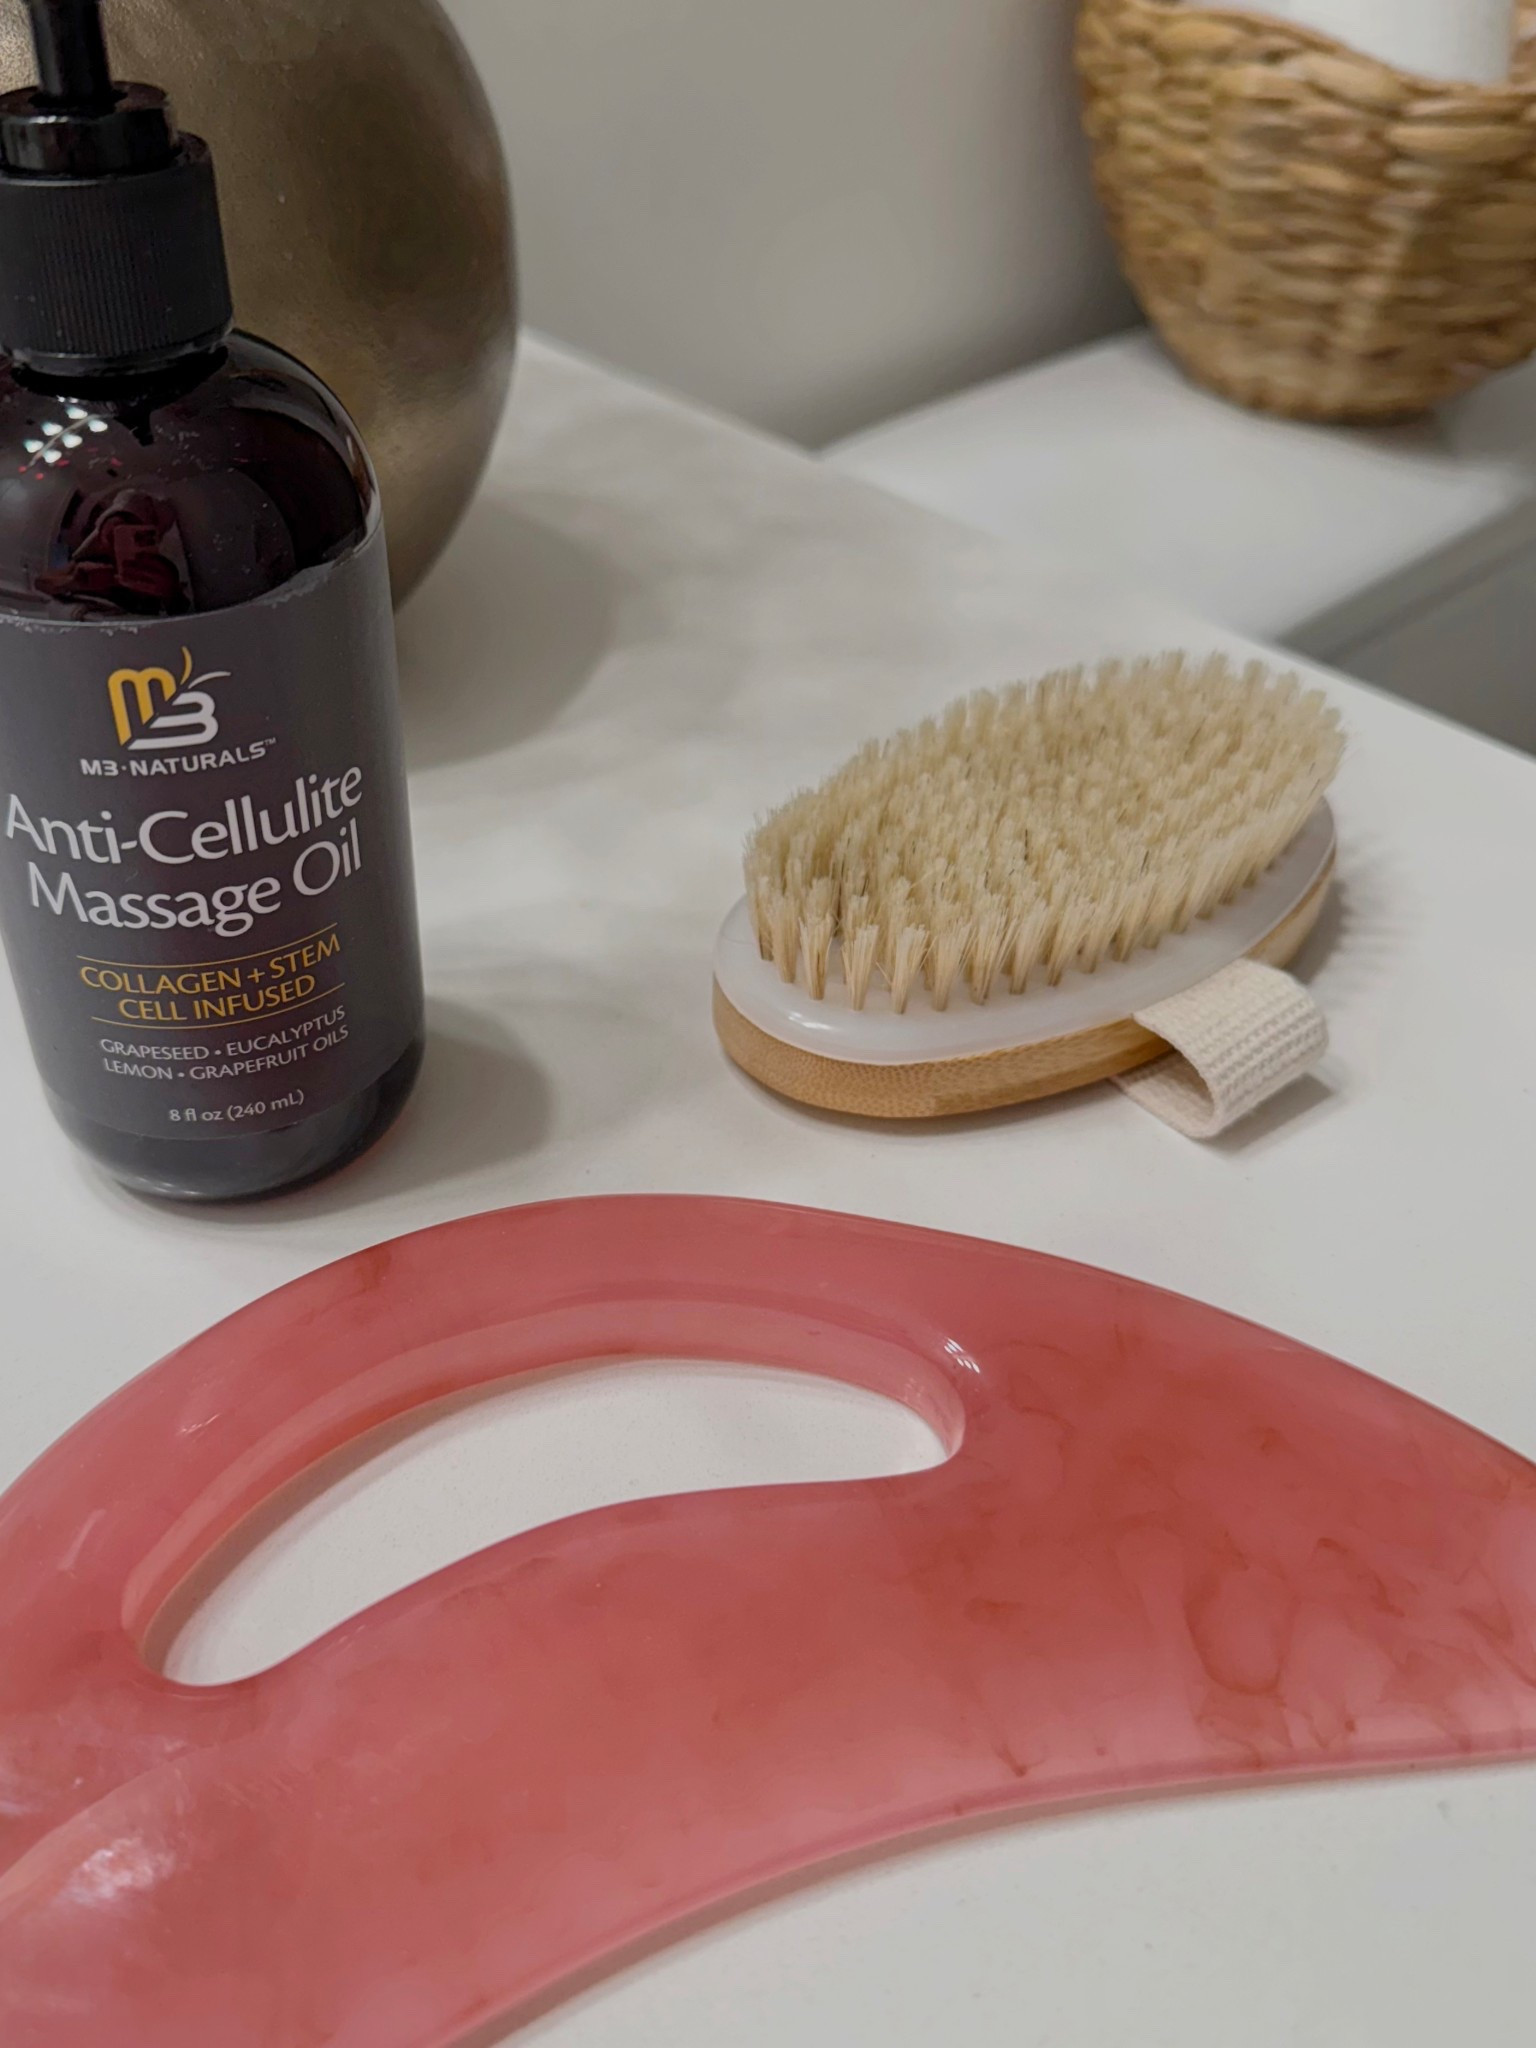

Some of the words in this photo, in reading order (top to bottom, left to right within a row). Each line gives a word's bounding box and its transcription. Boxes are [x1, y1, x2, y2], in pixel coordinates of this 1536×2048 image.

[5, 766, 363, 865] Anti-Cellulite
[27, 861, 282, 938] Massage
[292, 817, 362, 896] Oil
[79, 966, 241, 995] COLLAGEN
[269, 933, 341, 979] STEM
[118, 998, 188, 1021] CELL
[194, 974, 316, 1020] INFUSED
[99, 1037, 210, 1060] GRAPESEED
[227, 1005, 347, 1057] EUCALYPTUS
[103, 1058, 173, 1080] LEMON
[189, 1043, 309, 1080] GRAPEFRUIT
[313, 1025, 350, 1052] OILS
[169, 1108, 181, 1122] 8
[183, 1107, 198, 1122] fl
[202, 1109, 224, 1122] oz
[227, 1102, 267, 1122] (240
[270, 1089, 305, 1111] mL)
